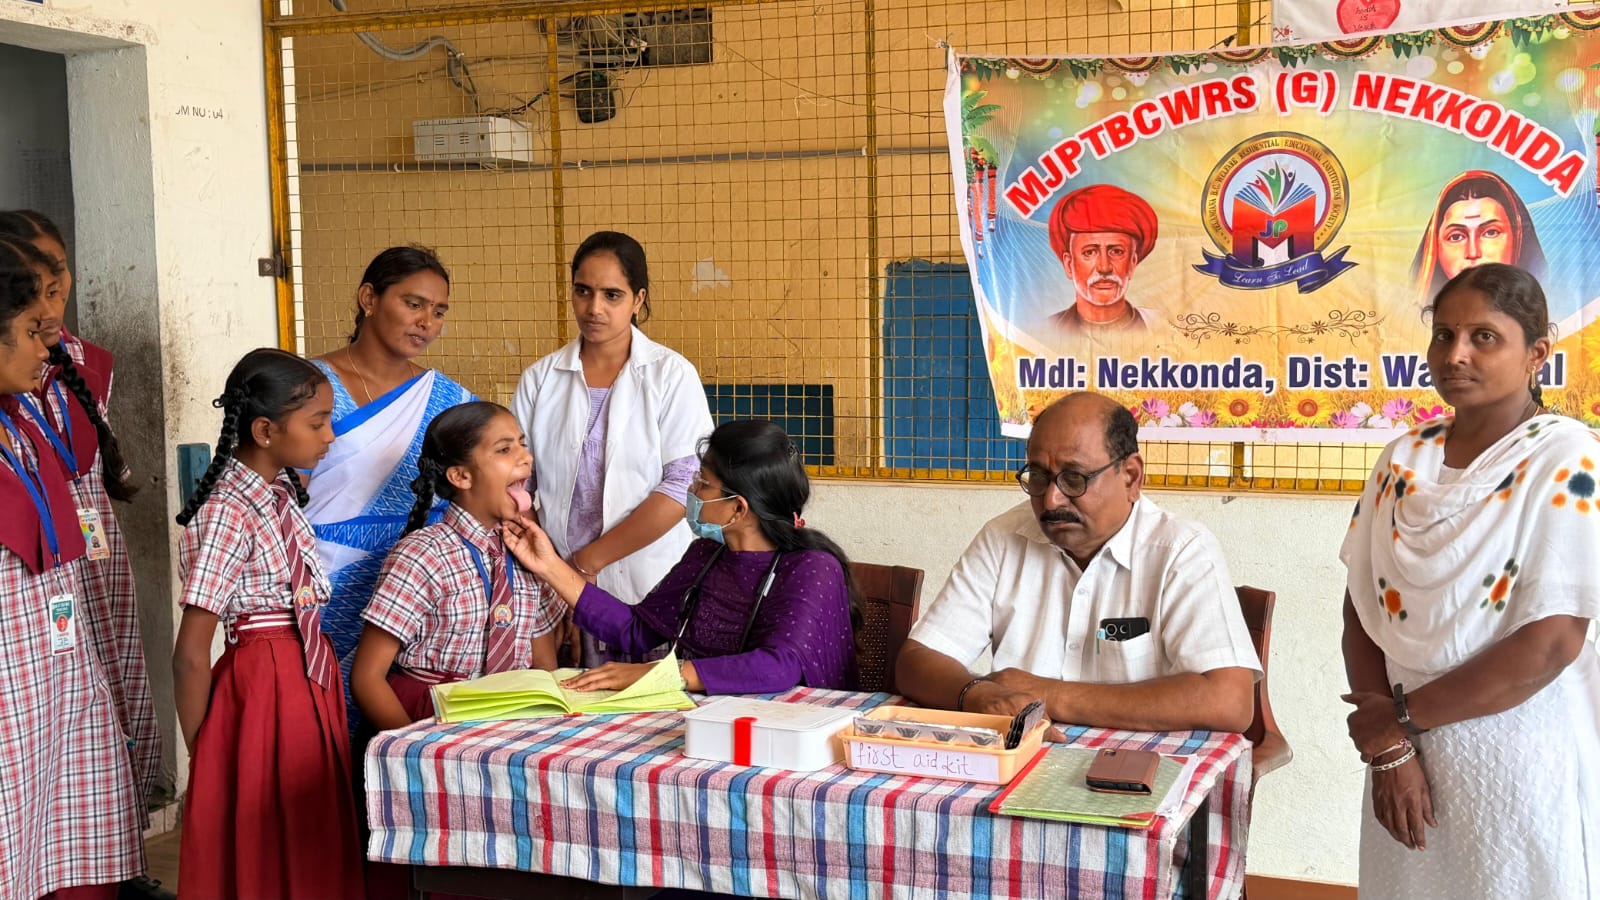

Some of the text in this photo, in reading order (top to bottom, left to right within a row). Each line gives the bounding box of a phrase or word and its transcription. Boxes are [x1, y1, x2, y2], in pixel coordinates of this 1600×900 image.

[1005, 71, 1587, 217] MJPTBCWRS (G) NEKKONDA
[1239, 139, 1280, 159] RESIDENTIAL
[1284, 139, 1323, 161] EDUCATIONAL
[1232, 258, 1309, 284] Learn To Lead
[1019, 358, 1087, 388] Mdl:
[1097, 357, 1275, 394] Nekkonda,
[1288, 357, 1369, 388] Dist:
[913, 751, 938, 769] aid
[942, 755, 974, 776] kit
